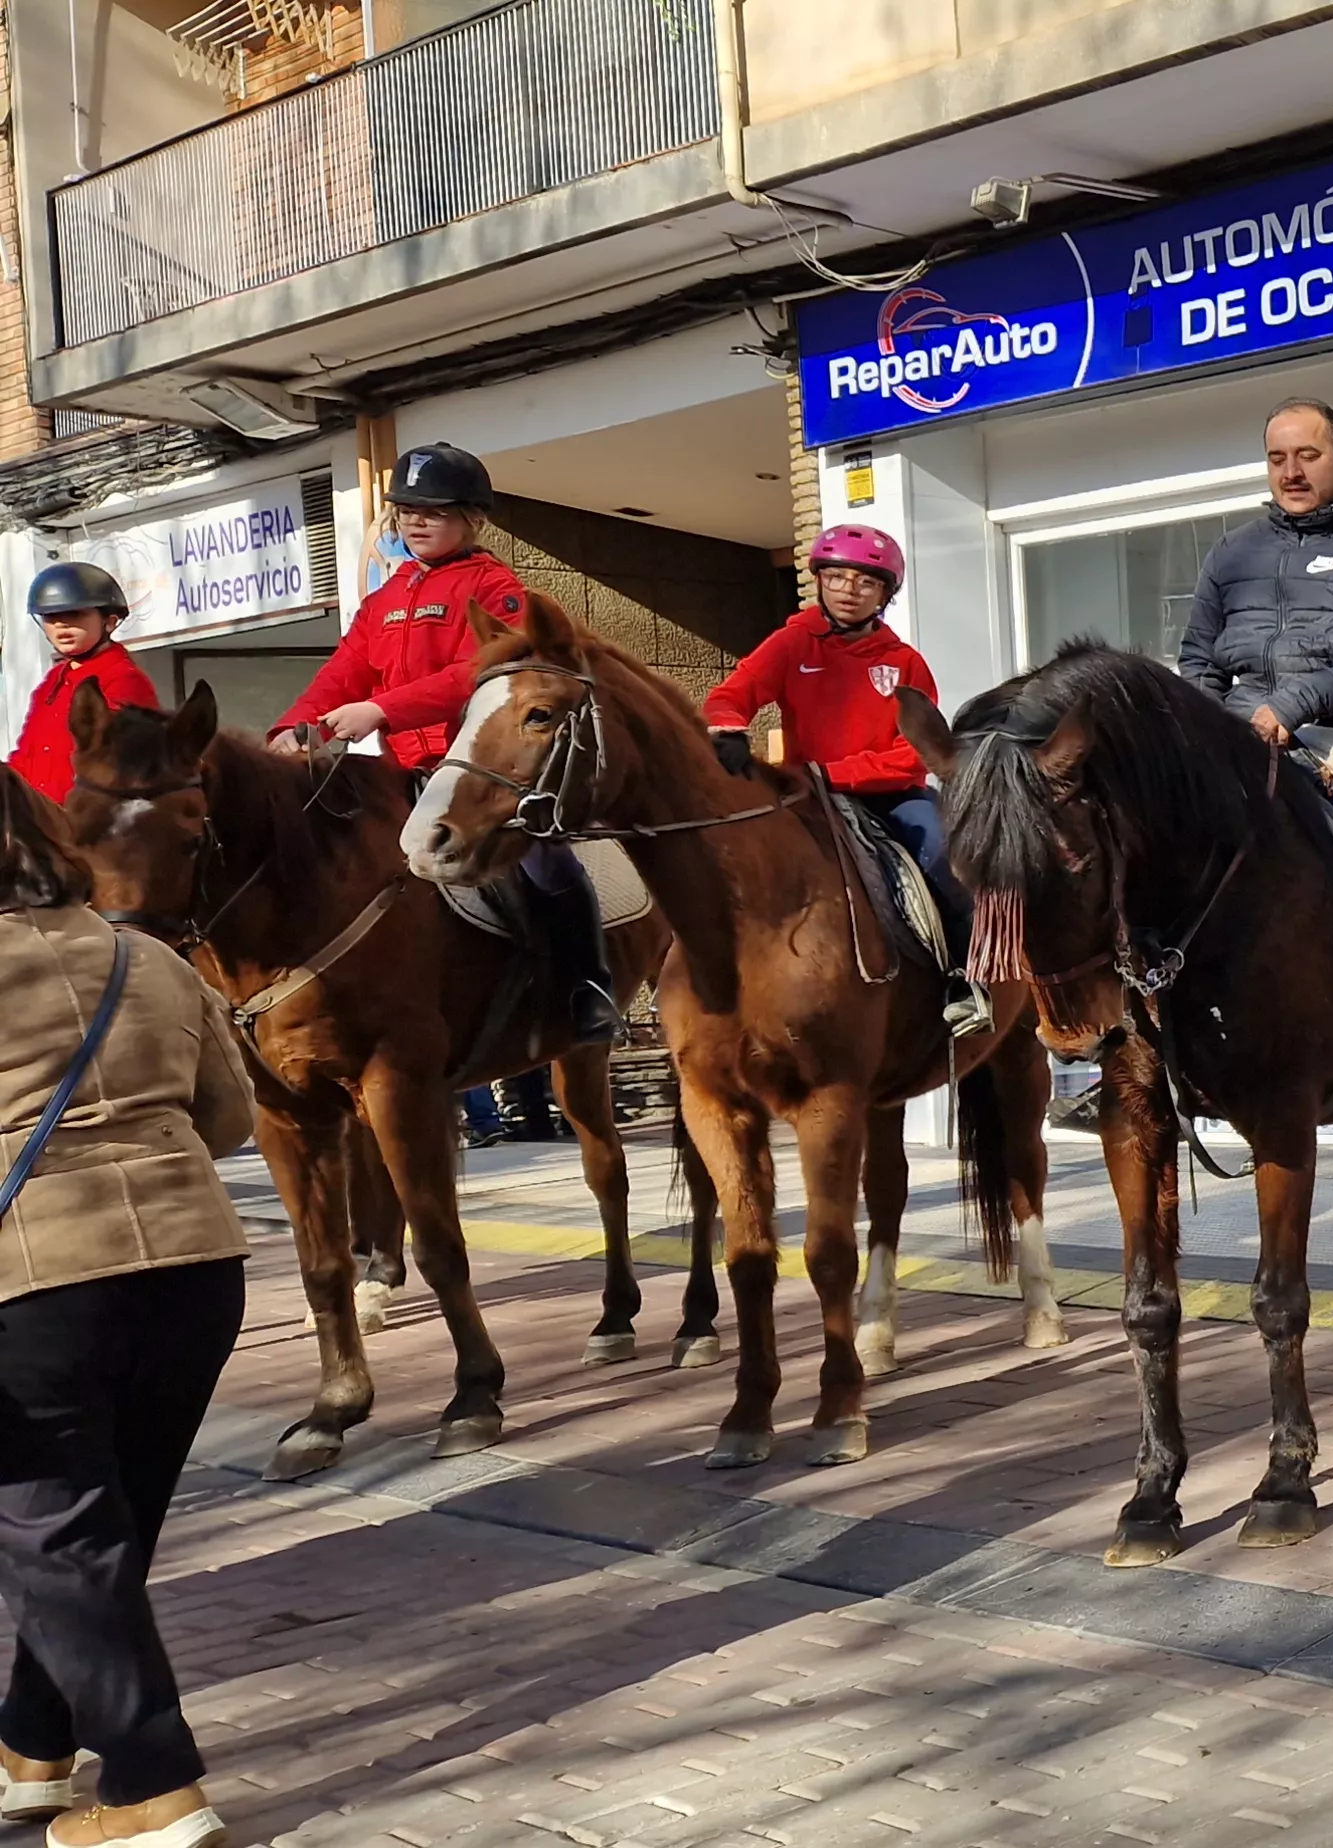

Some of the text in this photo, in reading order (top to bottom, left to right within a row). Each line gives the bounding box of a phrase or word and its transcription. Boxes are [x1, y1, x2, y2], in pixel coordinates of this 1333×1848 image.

[1181, 288, 1247, 346] DE
[829, 322, 1057, 399] ReparAuto
[169, 505, 297, 567] LAVANDERIA
[175, 556, 302, 616] Autoservicio
